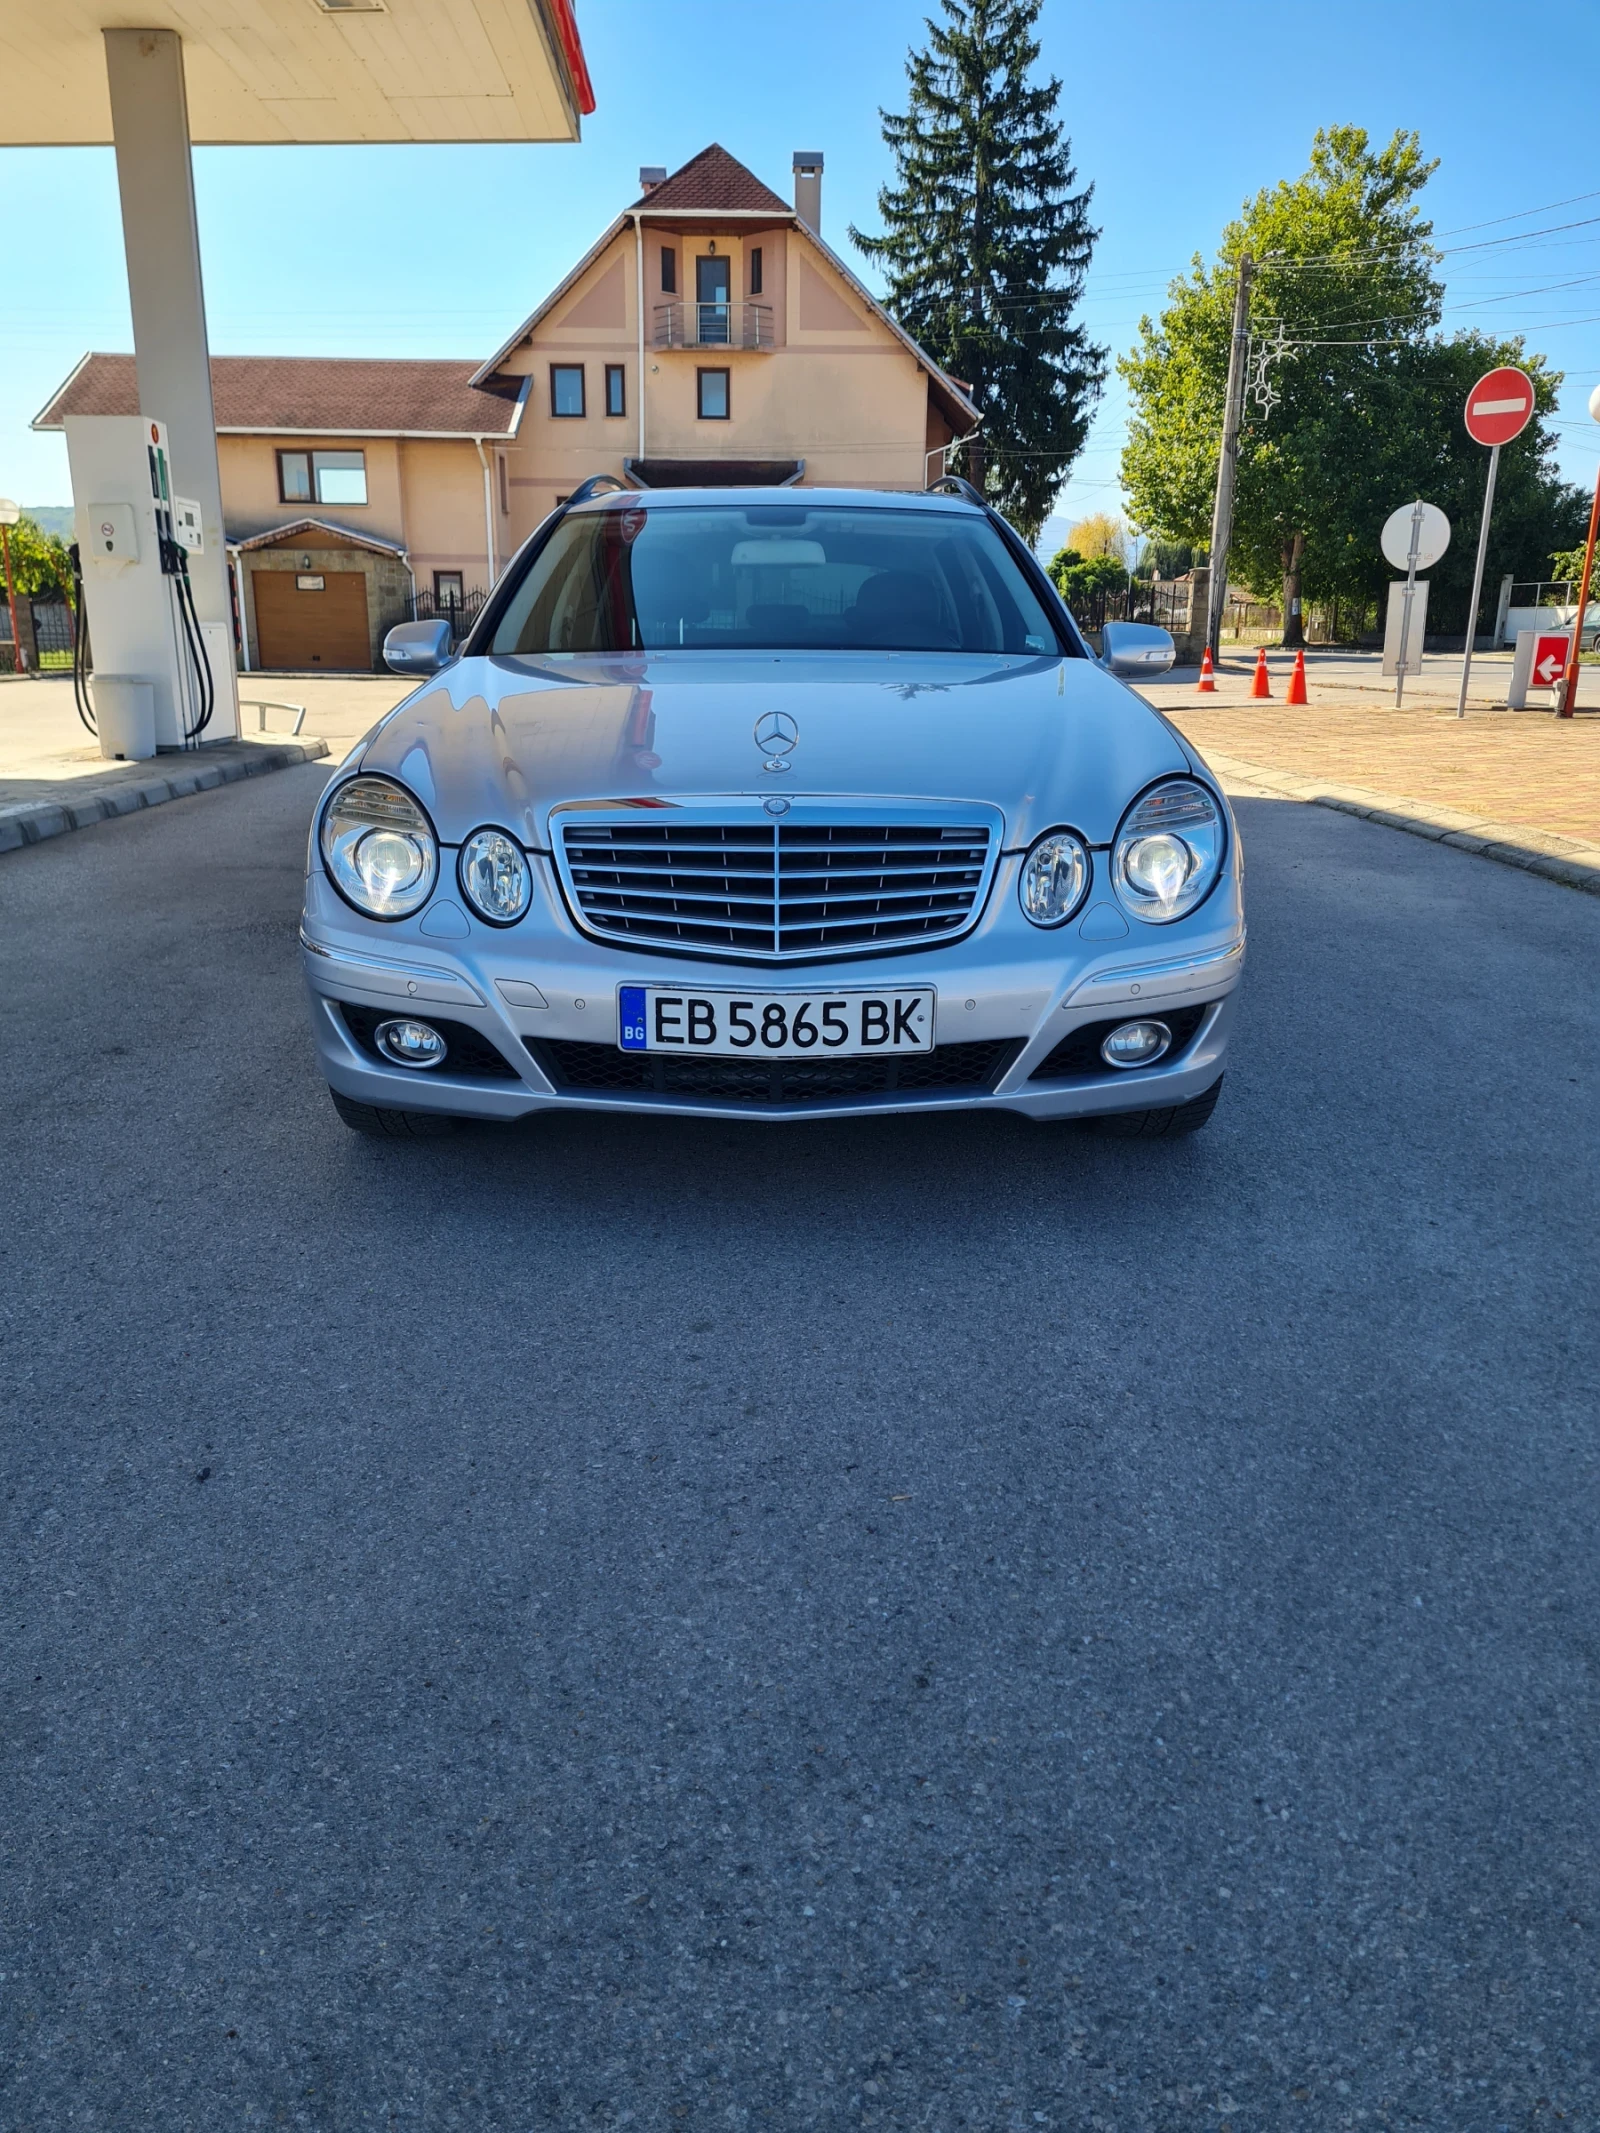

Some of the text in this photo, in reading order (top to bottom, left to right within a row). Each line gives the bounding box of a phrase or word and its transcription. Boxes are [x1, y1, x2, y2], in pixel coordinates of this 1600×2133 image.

[624, 1025, 645, 1040] BG
[655, 997, 922, 1049] EB 5865 BK
